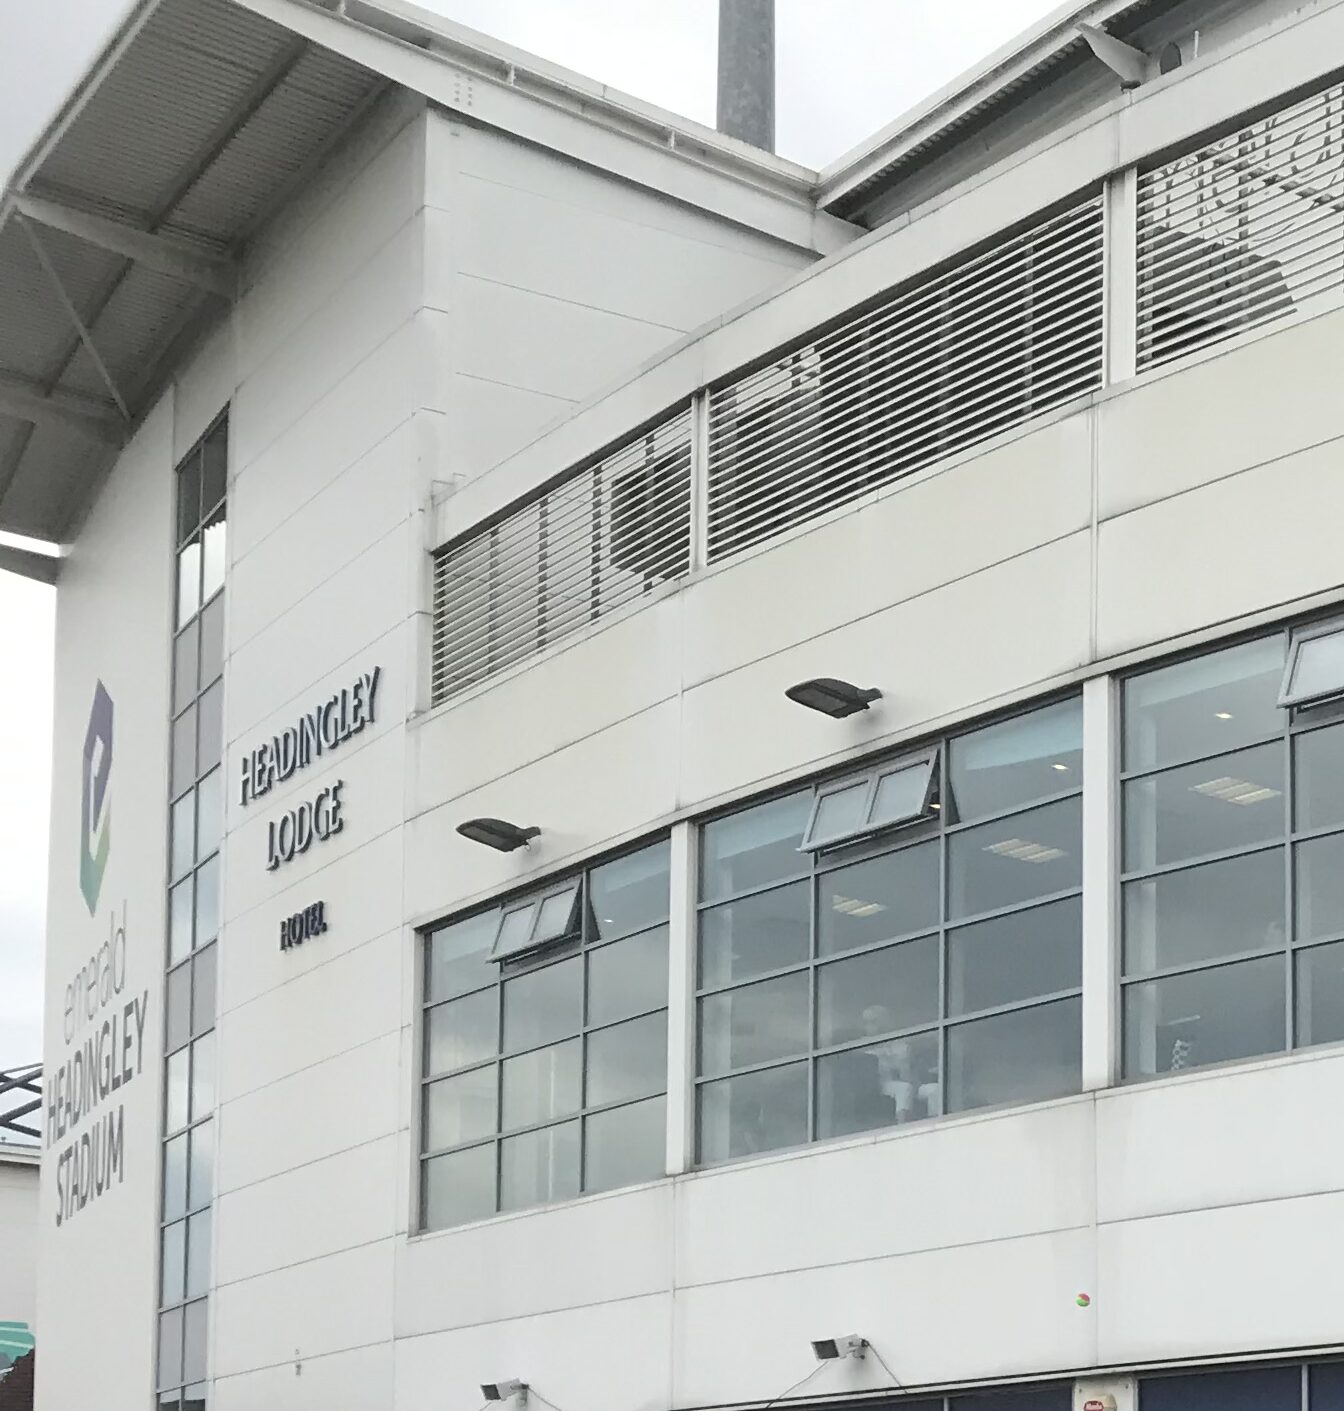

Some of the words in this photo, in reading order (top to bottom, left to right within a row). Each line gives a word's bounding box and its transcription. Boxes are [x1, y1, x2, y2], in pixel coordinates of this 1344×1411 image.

[238, 665, 382, 806] HEADINGLEY
[264, 779, 344, 871] LODGE
[63, 898, 128, 1044] emerald
[279, 900, 328, 952] HOTEL
[46, 990, 149, 1151] HEADINGLEY
[55, 1104, 125, 1228] STADIUM
